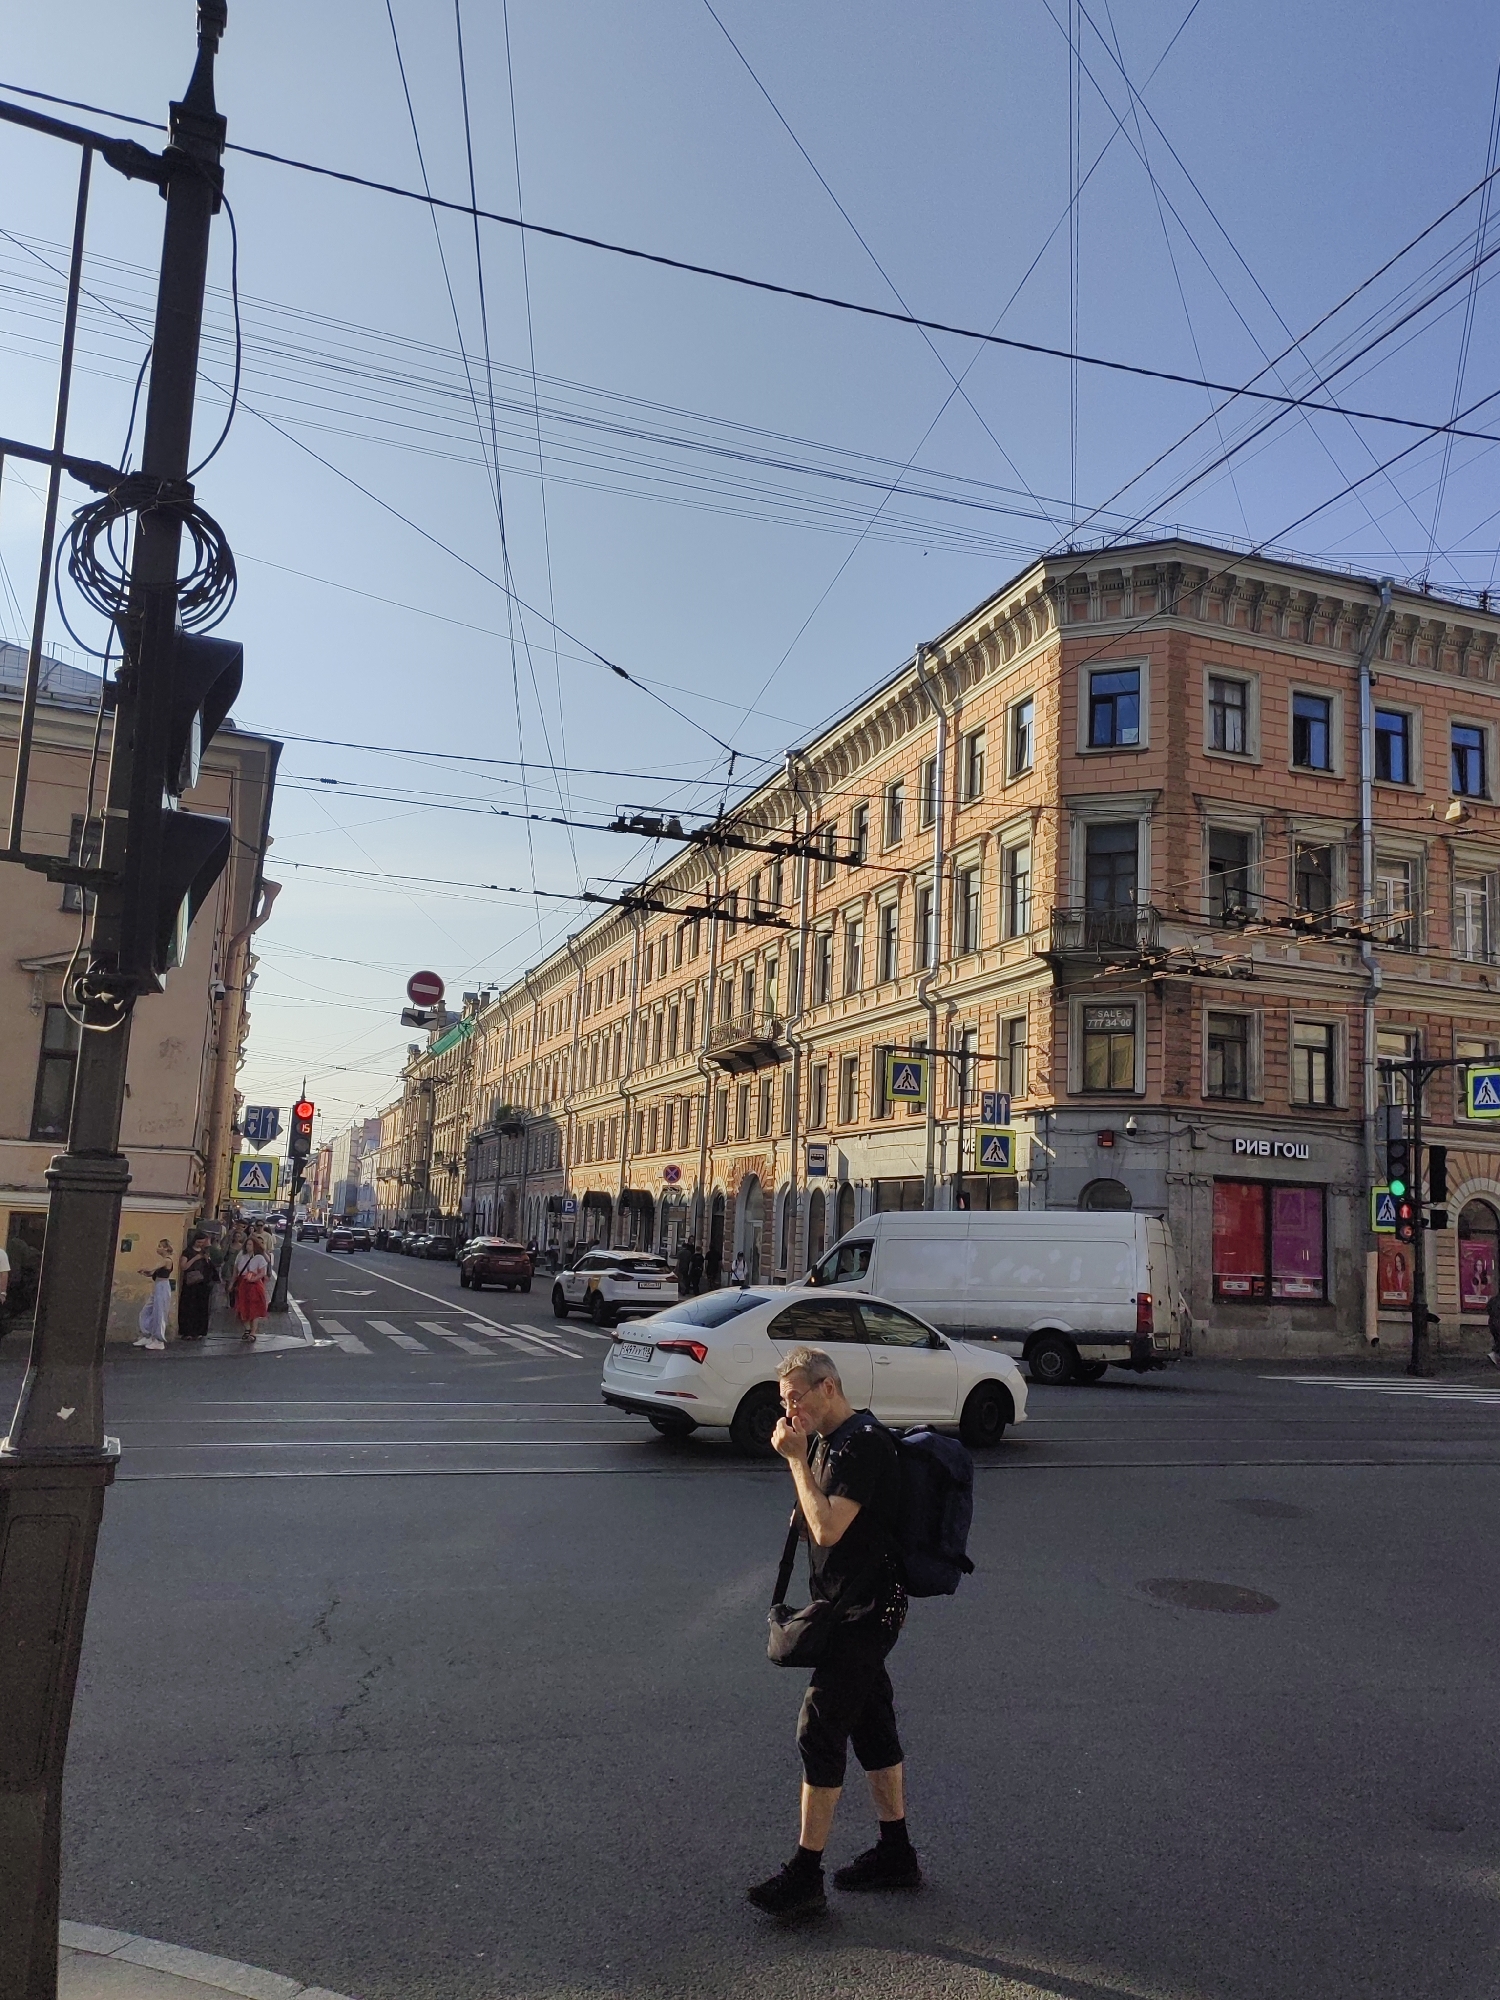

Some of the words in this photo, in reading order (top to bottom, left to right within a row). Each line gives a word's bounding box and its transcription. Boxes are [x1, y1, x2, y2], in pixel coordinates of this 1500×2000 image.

[1097, 1009, 1122, 1018] SALE
[1087, 1018, 1104, 1028] 777
[1105, 1018, 1117, 1027] 34
[1120, 1018, 1132, 1027] 00
[301, 1123, 311, 1133] 15
[1235, 1138, 1270, 1156] РИВ
[1274, 1141, 1309, 1159] ГОШ
